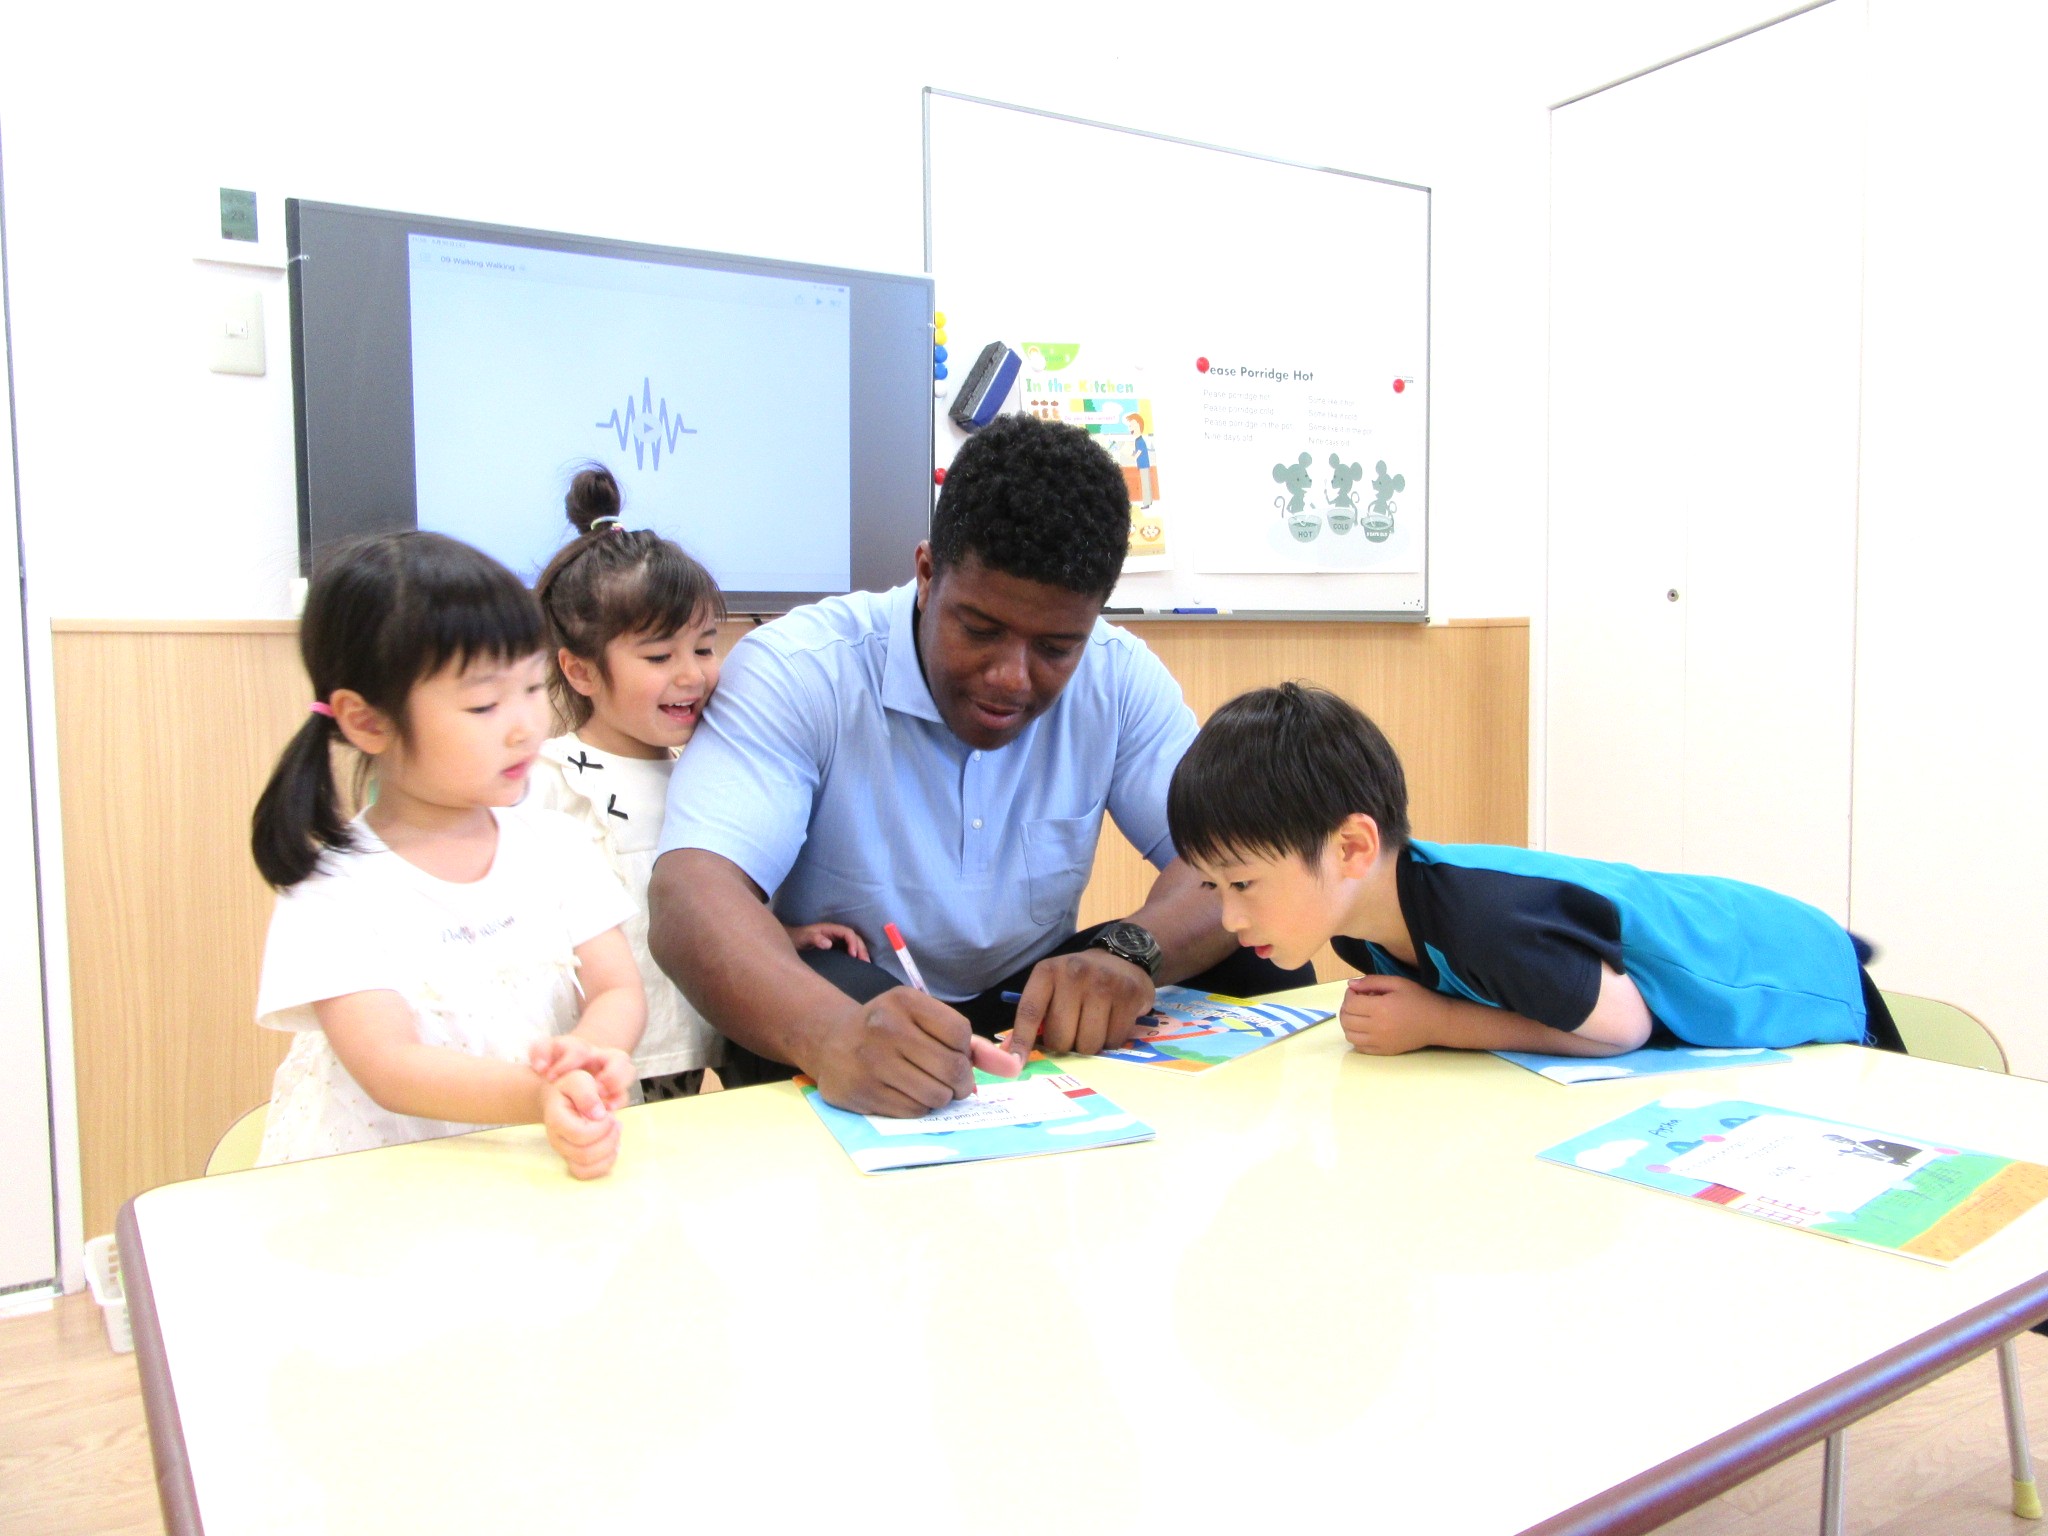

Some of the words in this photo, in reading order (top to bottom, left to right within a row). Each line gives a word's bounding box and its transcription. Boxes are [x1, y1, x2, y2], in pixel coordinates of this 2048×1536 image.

[453, 257, 484, 268] Walking
[485, 261, 515, 272] Walking
[1203, 365, 1236, 377] ease
[1240, 366, 1289, 382] Porridge
[1293, 370, 1314, 381] Hot
[1026, 378, 1042, 393] In
[1048, 377, 1072, 393] the
[1078, 379, 1134, 394] Kitchen
